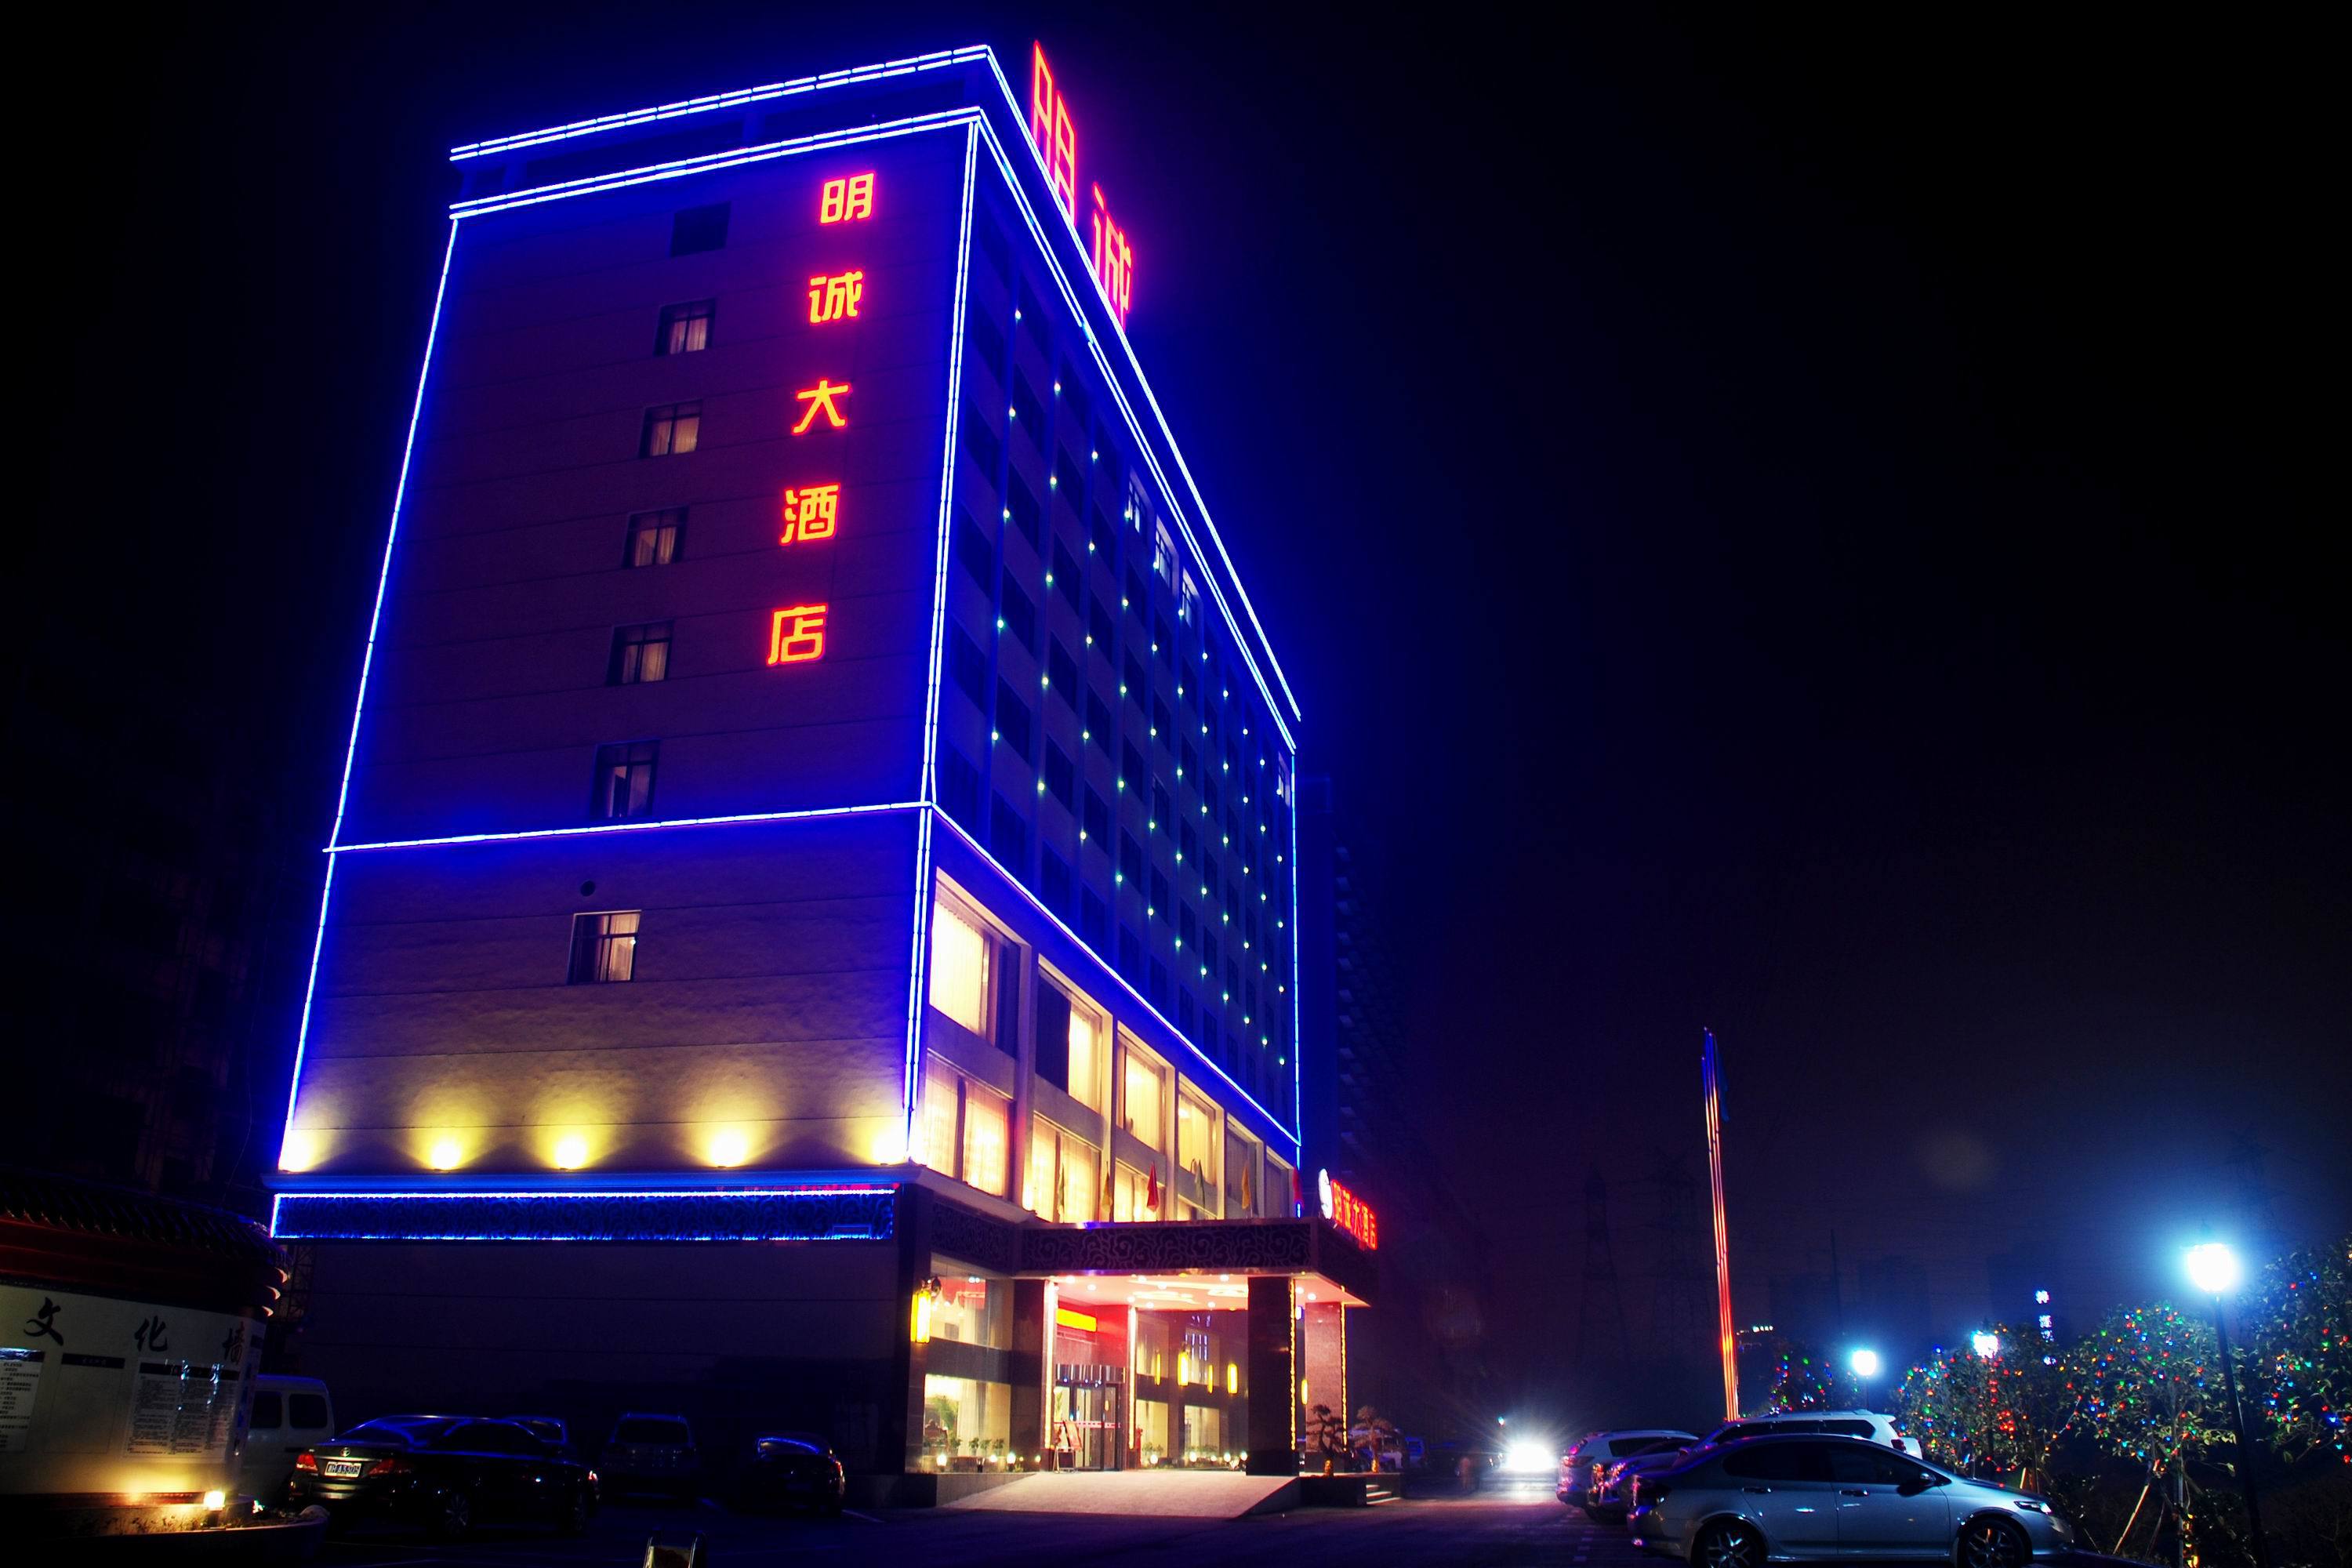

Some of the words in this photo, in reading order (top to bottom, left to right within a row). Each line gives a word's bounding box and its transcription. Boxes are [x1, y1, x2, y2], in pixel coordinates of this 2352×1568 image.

[767, 172, 876, 666] 明诚大酒店
[24, 1297, 245, 1363] 文化墙
